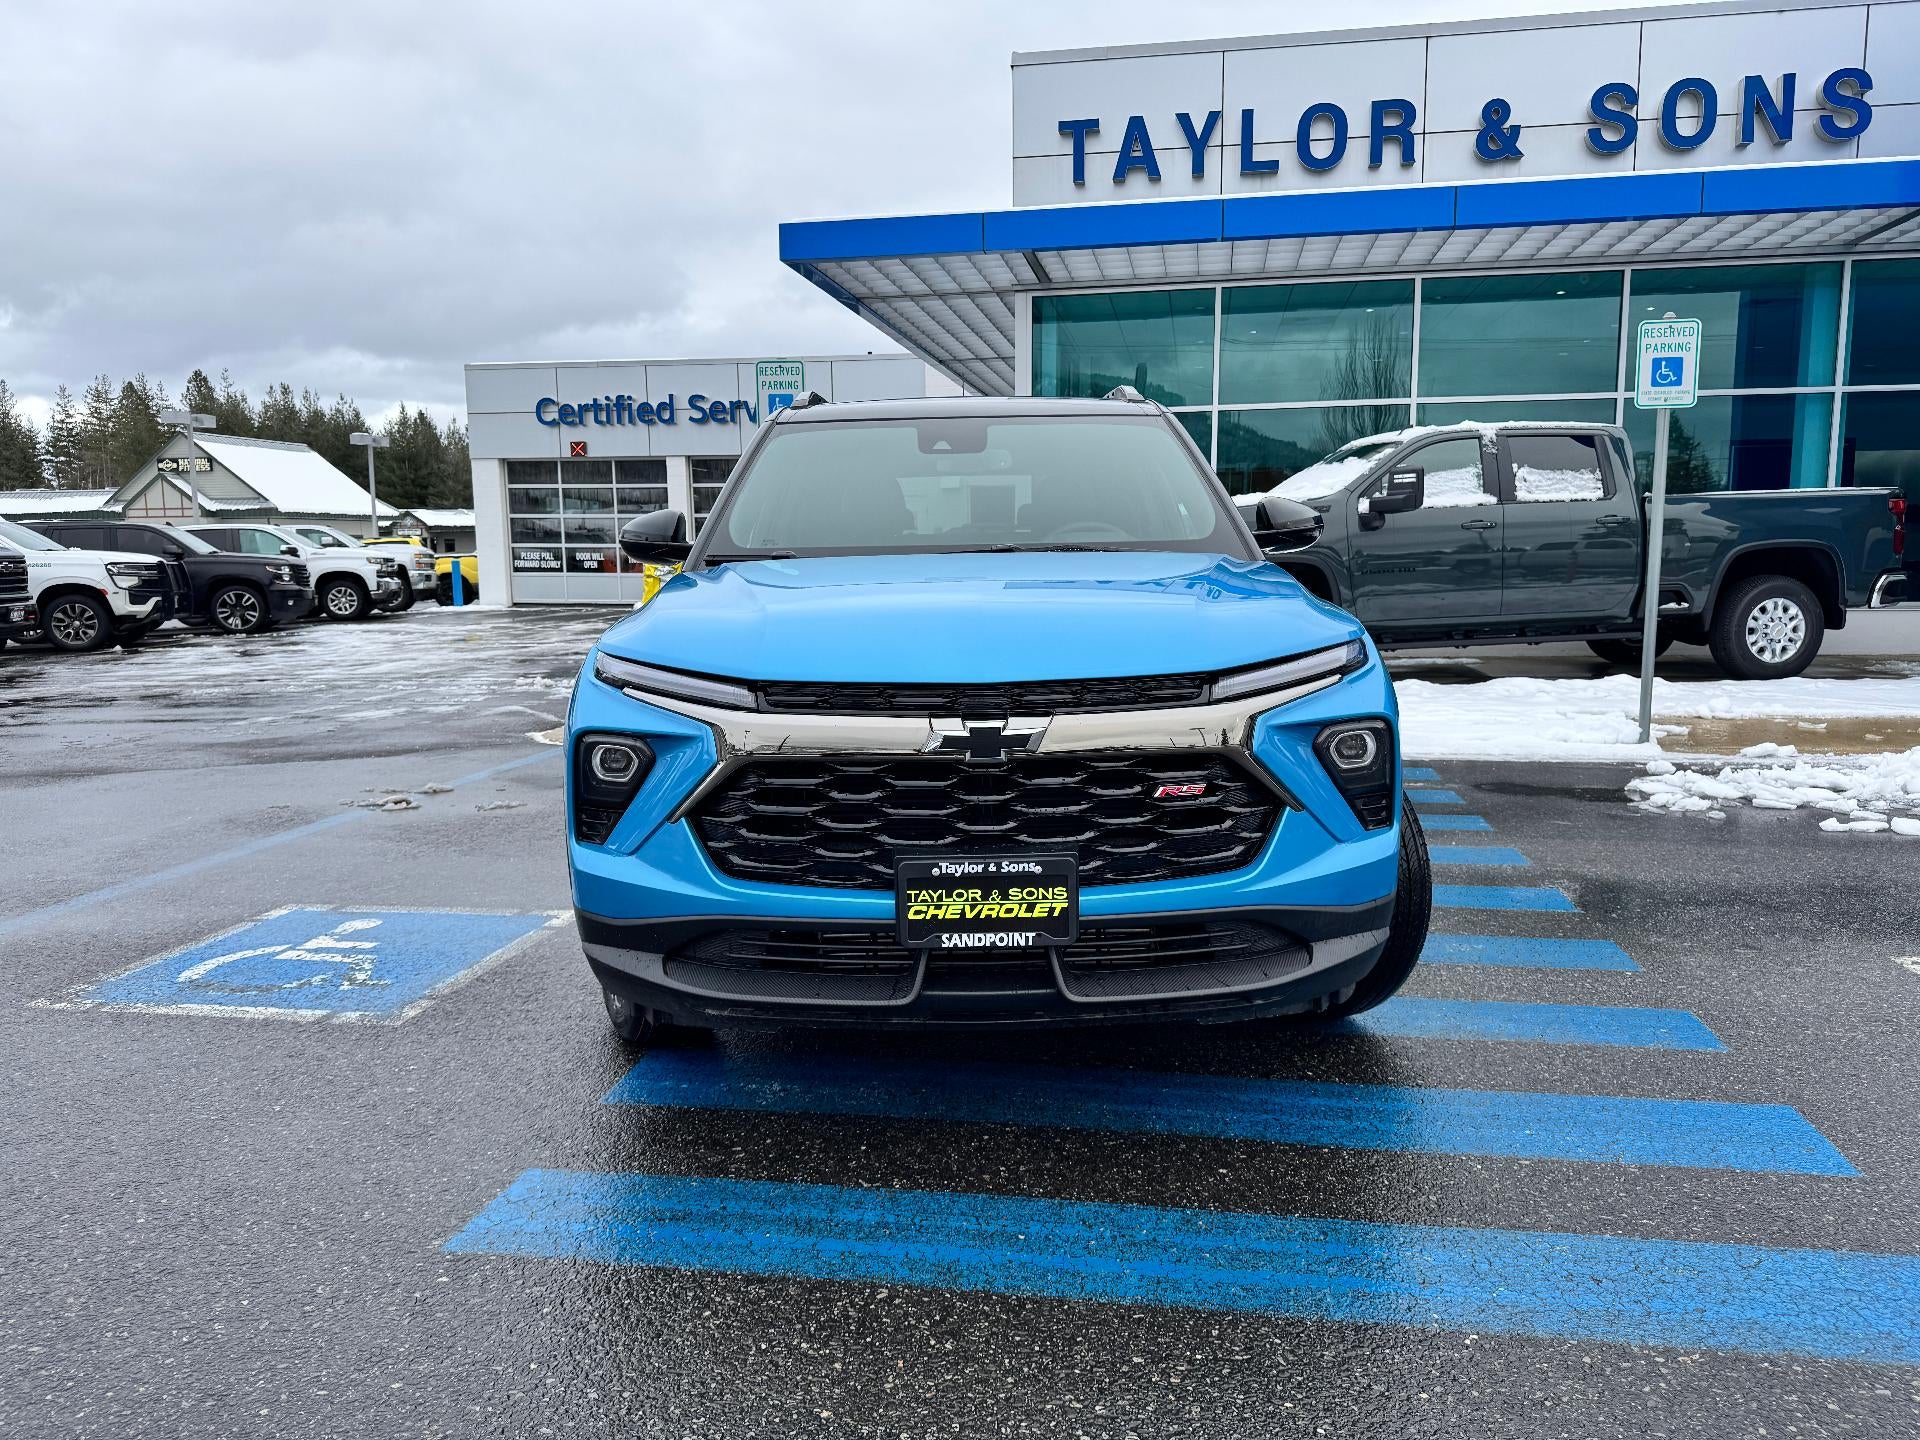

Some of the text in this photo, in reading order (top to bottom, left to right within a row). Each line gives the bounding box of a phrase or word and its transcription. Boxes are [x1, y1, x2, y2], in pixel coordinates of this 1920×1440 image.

[1058, 67, 1874, 186] TAYLOR & SONS
[1643, 326, 1695, 339] RESERVED
[1645, 341, 1692, 354] PARKING
[759, 366, 801, 377] RESERVED
[761, 380, 799, 391] PARKING
[535, 393, 677, 427] Certified
[520, 552, 554, 560] PLEASE PULL
[575, 552, 605, 560] DOOR WILL
[514, 560, 561, 568] FORWARD SLOWLY
[583, 560, 598, 568] OPEN
[1152, 783, 1207, 798] RS
[939, 861, 1036, 877] Taylor & Sons
[907, 887, 1068, 904] TAYLOR & SONS
[907, 902, 1068, 920] CHEVROLET
[941, 932, 1036, 947] SANDPOINT
